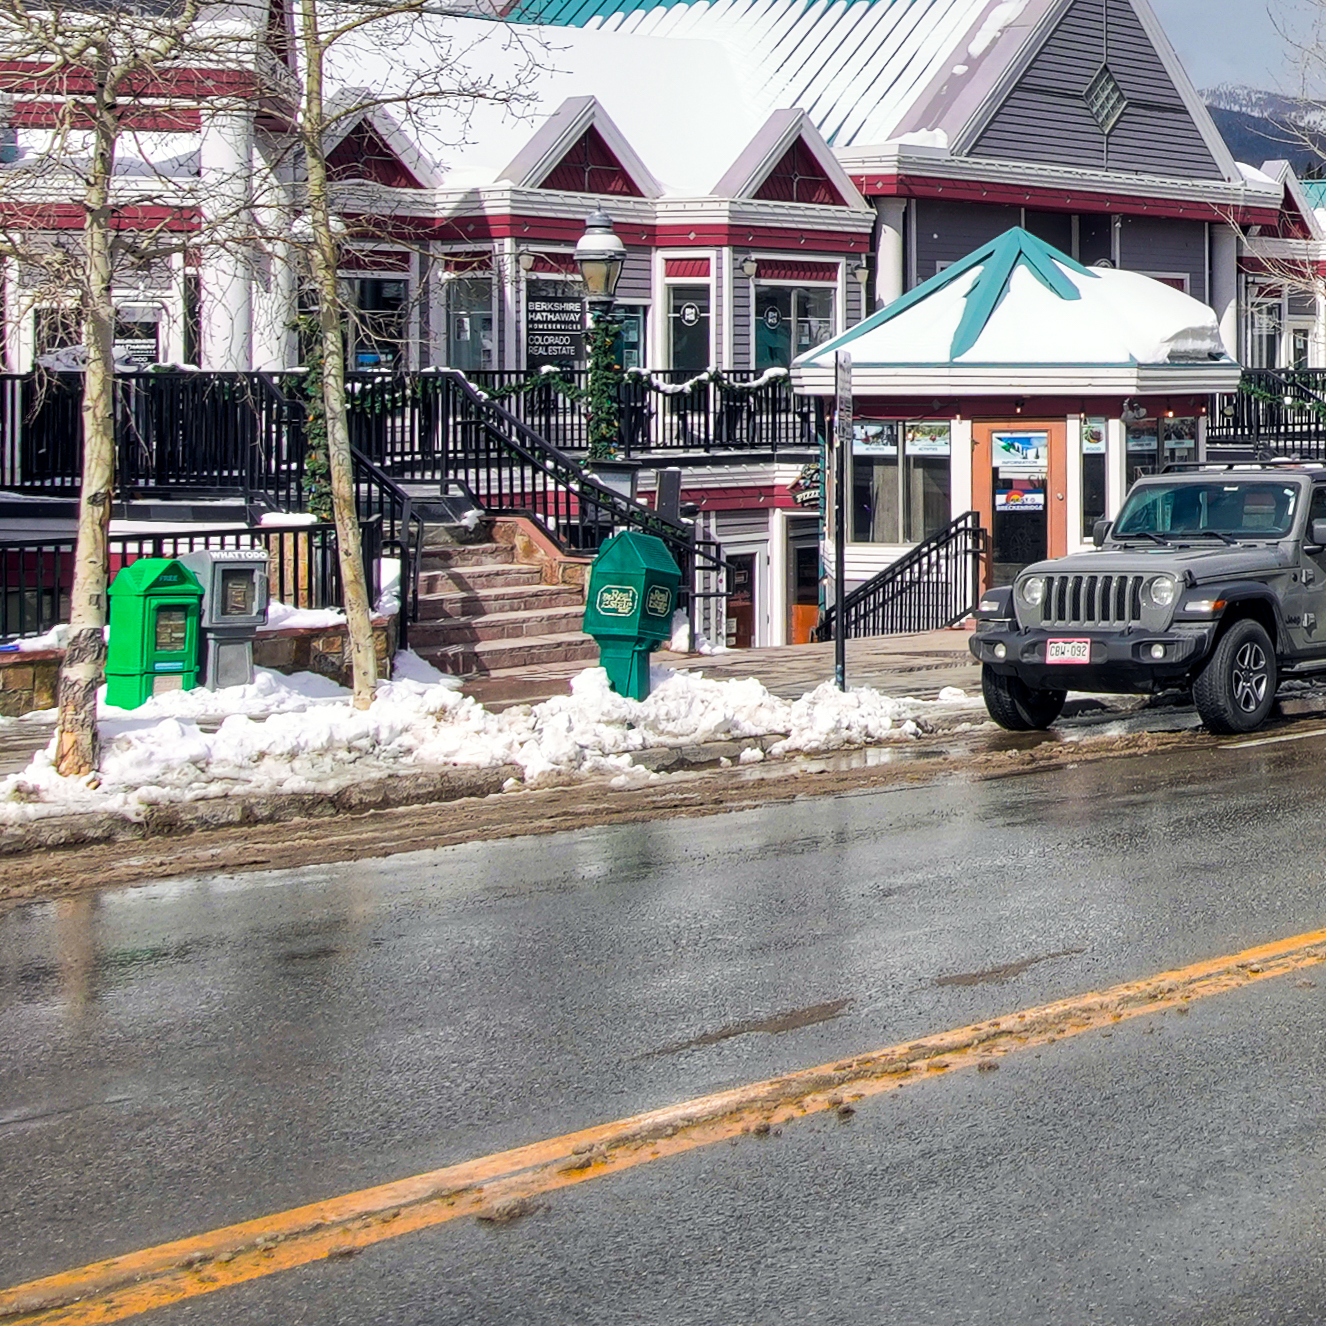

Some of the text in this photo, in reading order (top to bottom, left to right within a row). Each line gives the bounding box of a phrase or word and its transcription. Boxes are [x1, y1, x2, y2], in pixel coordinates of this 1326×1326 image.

[528, 302, 581, 312] BERKSHIRE
[528, 312, 581, 322] HATHAWAY
[528, 335, 571, 345] COLORADO
[528, 346, 576, 355] REAL ESTATE
[1050, 645, 1087, 657] CBW-092
